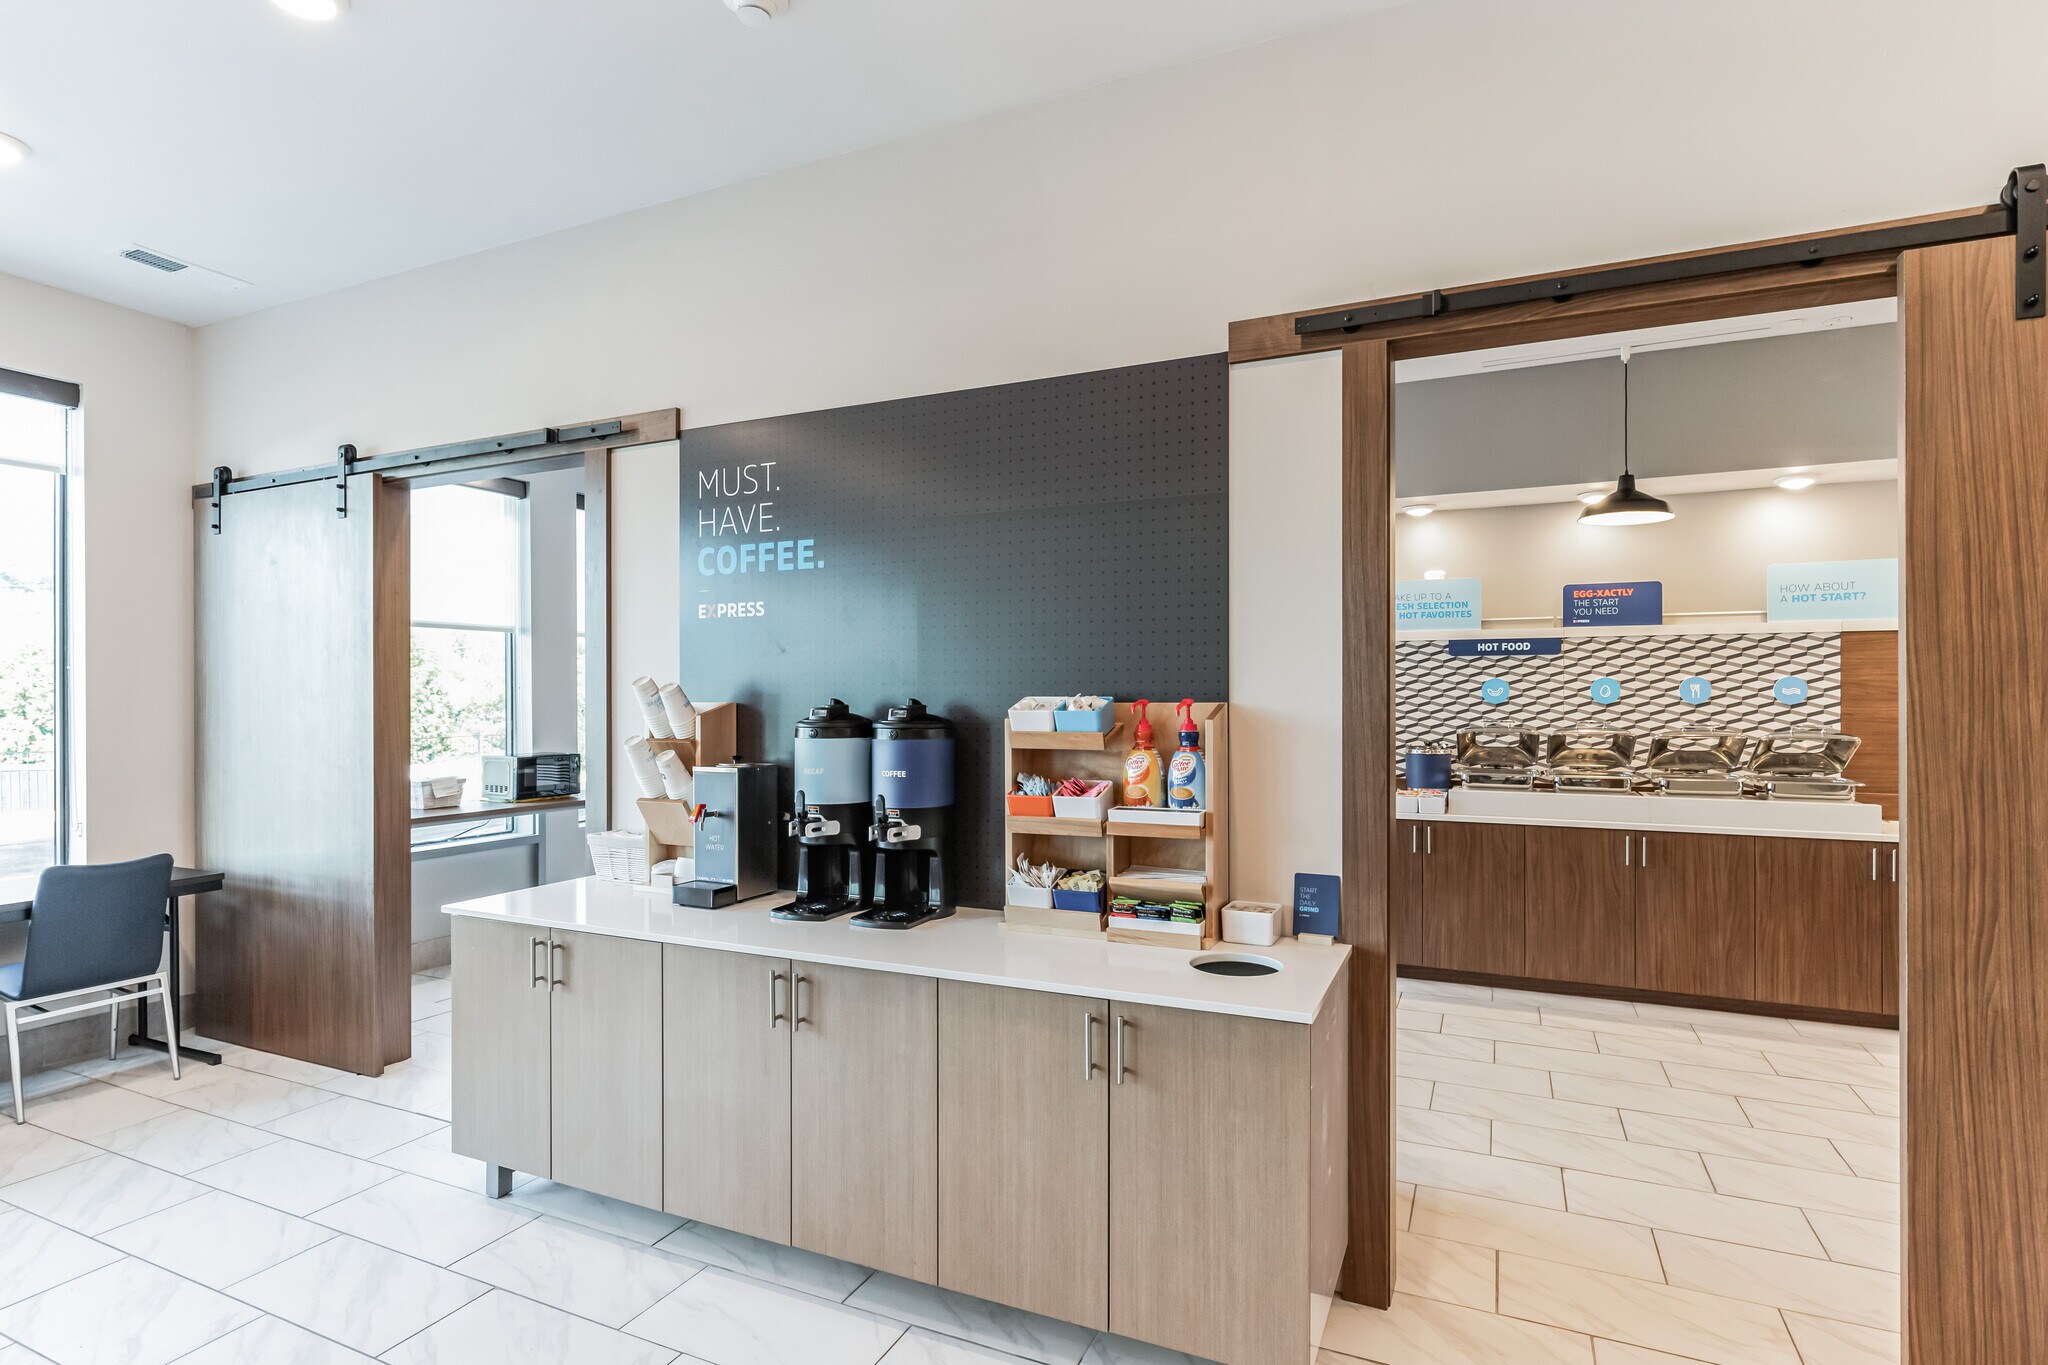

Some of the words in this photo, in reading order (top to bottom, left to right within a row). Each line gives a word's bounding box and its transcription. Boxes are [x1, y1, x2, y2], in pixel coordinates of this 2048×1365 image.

[699, 462, 780, 499] MUST.
[699, 502, 780, 537] HAVE.
[698, 539, 825, 576] COFFEE.
[1780, 584, 1810, 593] HOW
[1814, 581, 1856, 591] ABOUT
[1395, 593, 1411, 602] AKE
[1414, 593, 1427, 601] UP
[1430, 592, 1442, 601] TO
[1445, 592, 1452, 600] A
[1573, 588, 1634, 598] EGG-XACTLY
[1780, 595, 1788, 603] A
[1791, 594, 1817, 603] HOT
[1820, 592, 1866, 602] START?
[1417, 601, 1469, 610] SELECTION
[1573, 599, 1590, 607] THE
[1592, 598, 1619, 607] START
[698, 601, 765, 619] EXPRESS
[1399, 612, 1418, 620] HOT
[1421, 610, 1472, 619] FAVORITES
[1573, 608, 1592, 616] YOU
[1595, 607, 1619, 615] NEED
[1477, 643, 1499, 651] HOT
[1501, 642, 1531, 651] FOOD
[705, 843, 725, 851] WATER
[1299, 905, 1319, 913] GRIND
